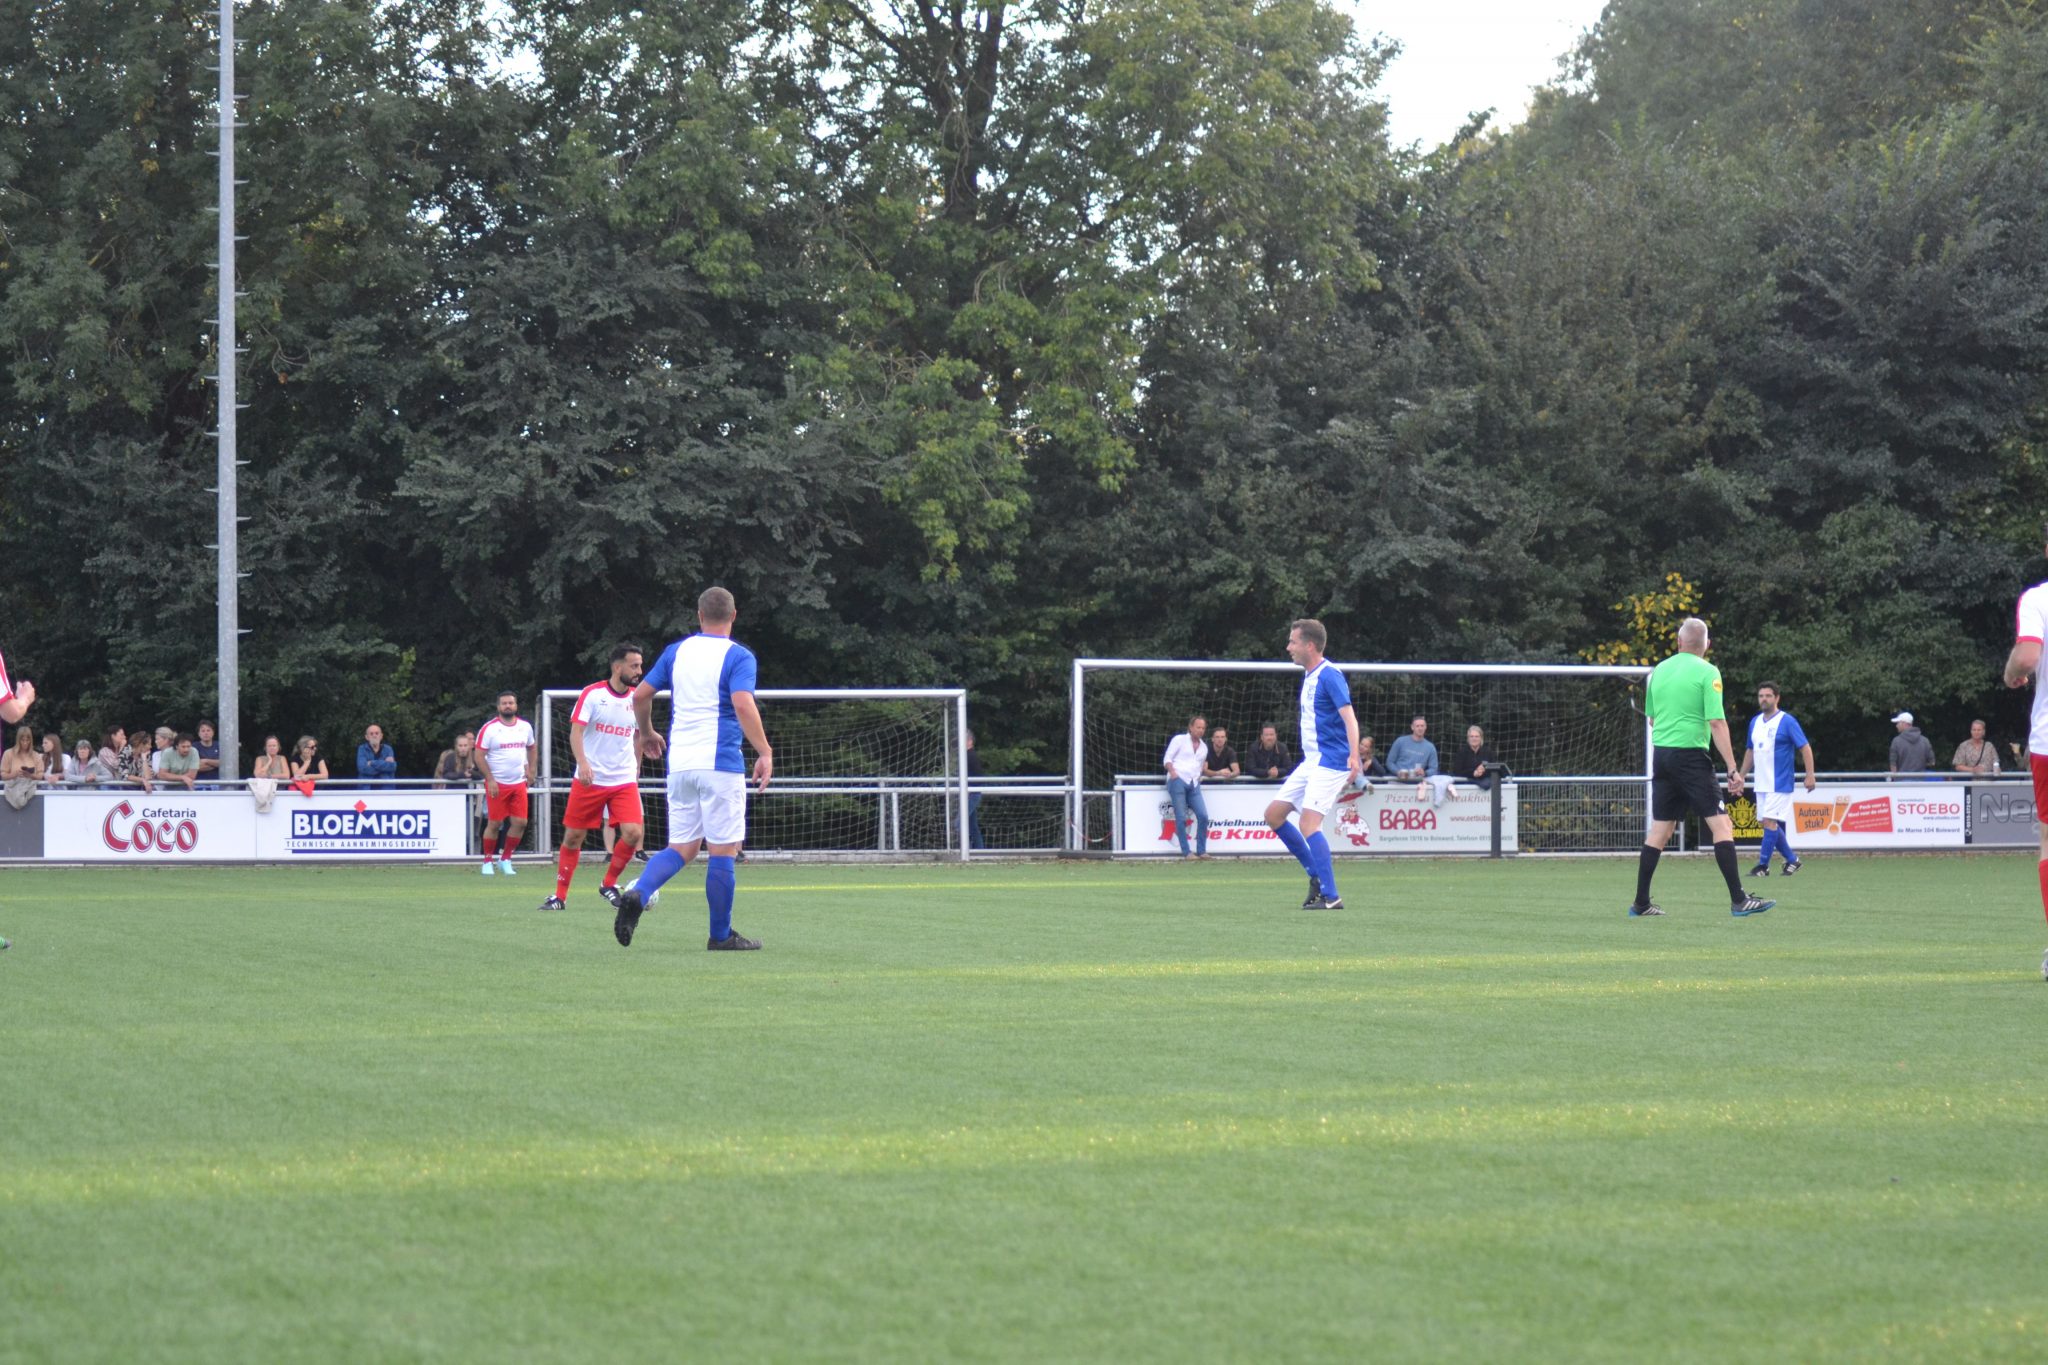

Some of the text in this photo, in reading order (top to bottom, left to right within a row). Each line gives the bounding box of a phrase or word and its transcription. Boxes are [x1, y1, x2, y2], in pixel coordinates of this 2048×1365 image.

[142, 808, 197, 818] Cafetaria
[1798, 807, 1829, 817] Autoruit
[1897, 803, 1960, 815] STOEBO
[294, 812, 429, 836] BLOEMHOF
[1380, 809, 1436, 830] BABA
[1804, 819, 1824, 829] stuk?
[102, 799, 199, 853] Coco
[1225, 829, 1280, 840] Kroo
